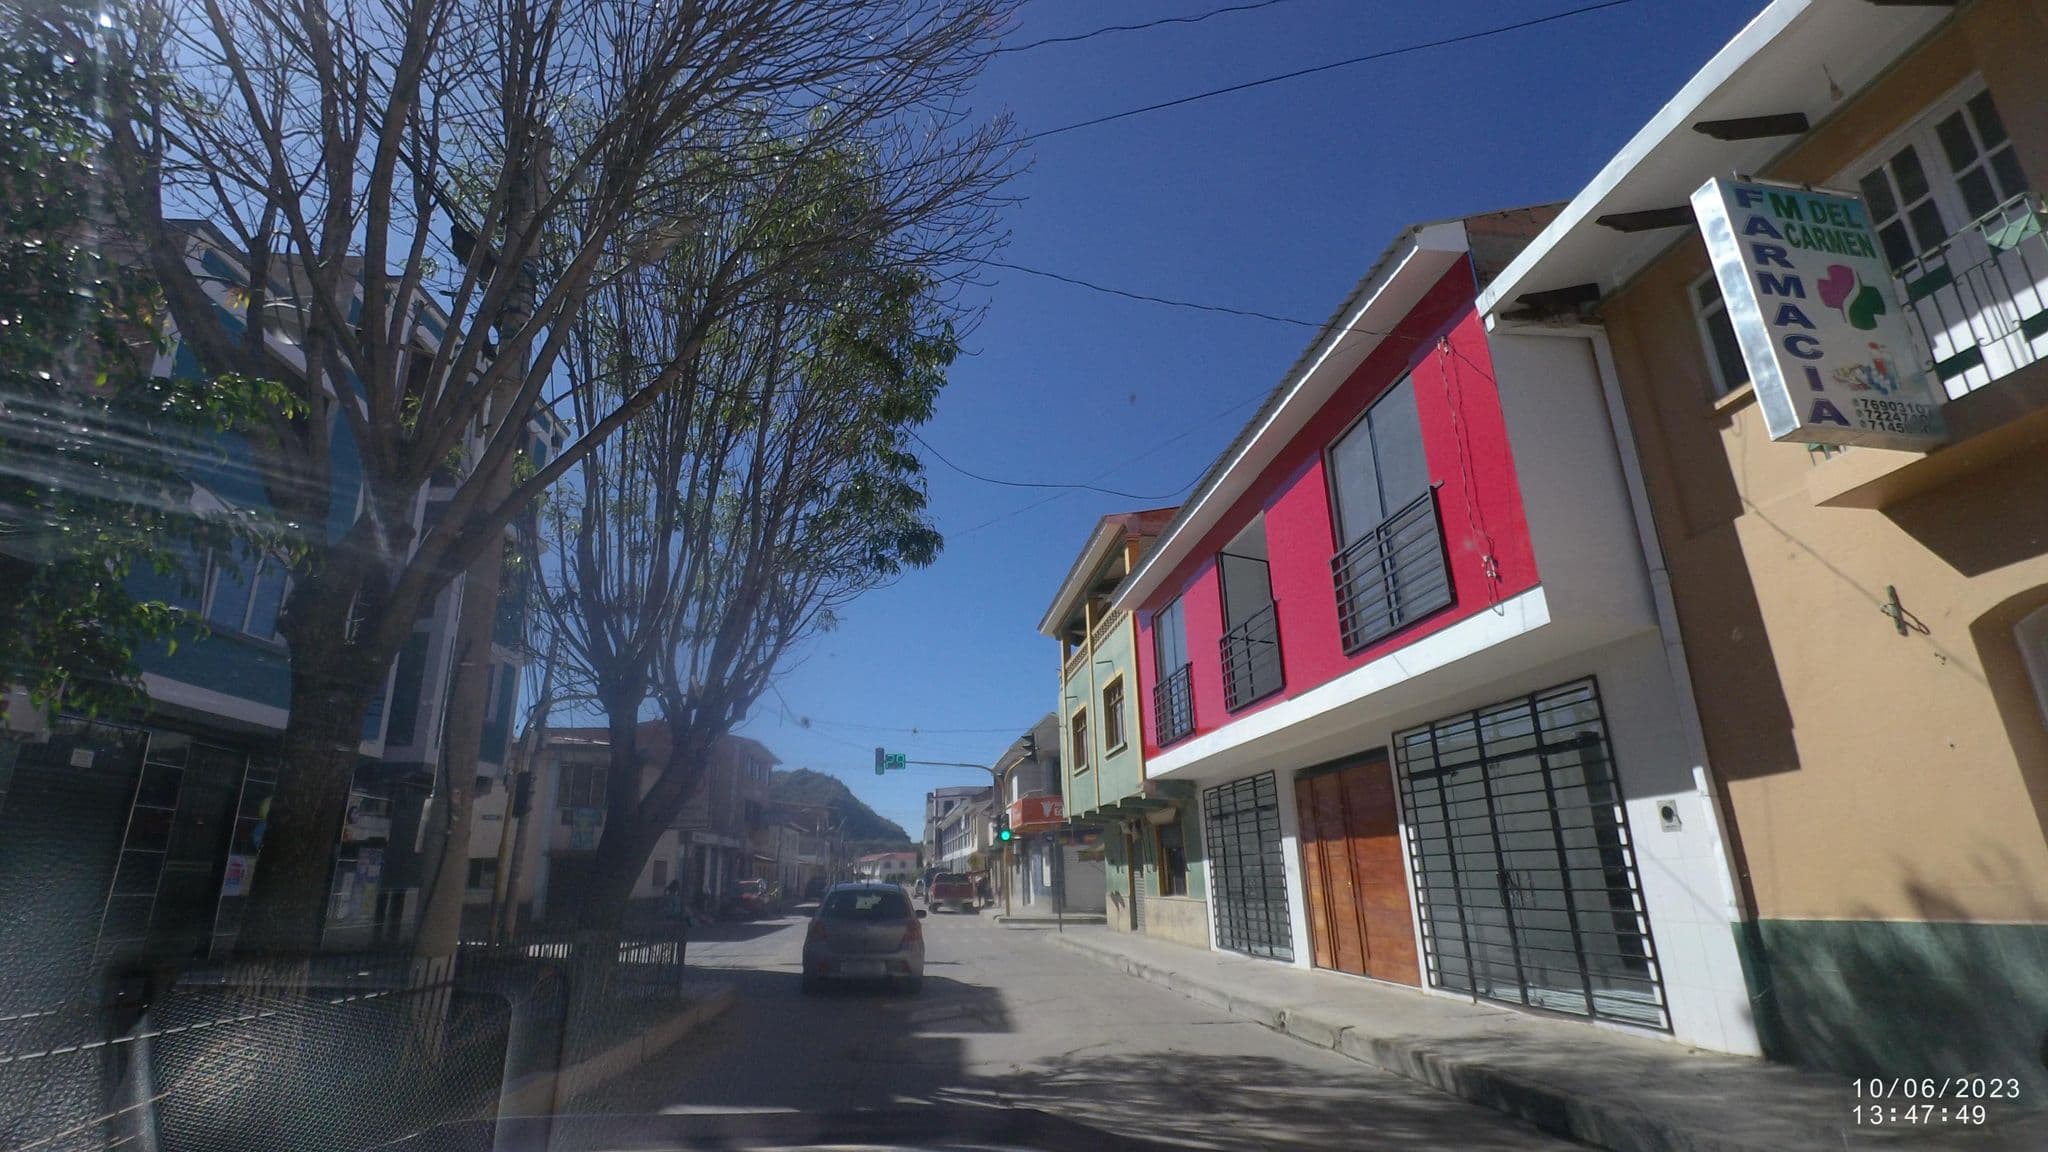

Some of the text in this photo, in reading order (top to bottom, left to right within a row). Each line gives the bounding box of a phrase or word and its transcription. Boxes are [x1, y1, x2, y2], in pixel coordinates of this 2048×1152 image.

[1768, 191, 1865, 230] M DEL
[1783, 222, 1878, 259] CARMEN
[1733, 187, 1850, 427] FARMACIA
